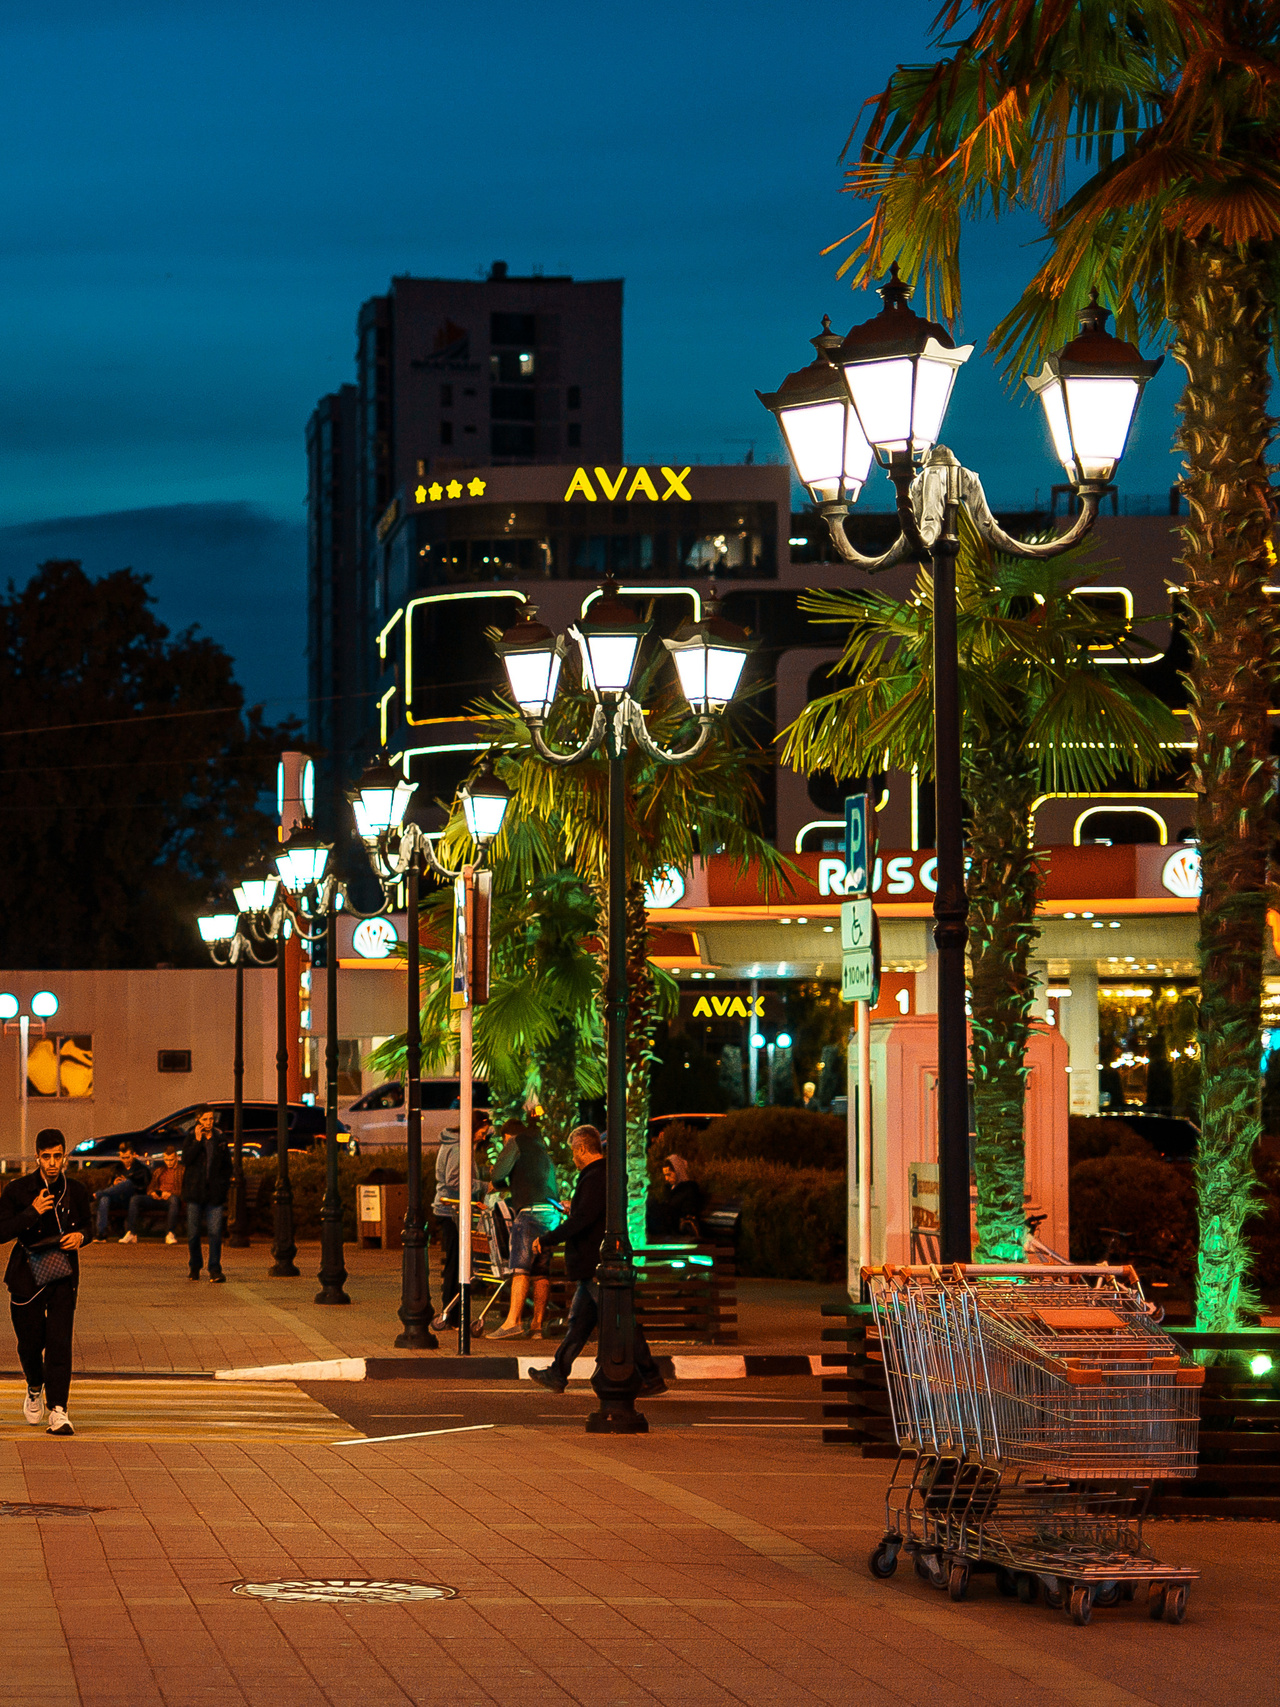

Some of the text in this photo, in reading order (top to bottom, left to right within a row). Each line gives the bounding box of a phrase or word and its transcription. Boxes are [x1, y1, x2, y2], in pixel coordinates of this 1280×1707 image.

[564, 466, 692, 502] AVAX
[692, 995, 766, 1018] AVAX
[894, 988, 910, 1015] 1
